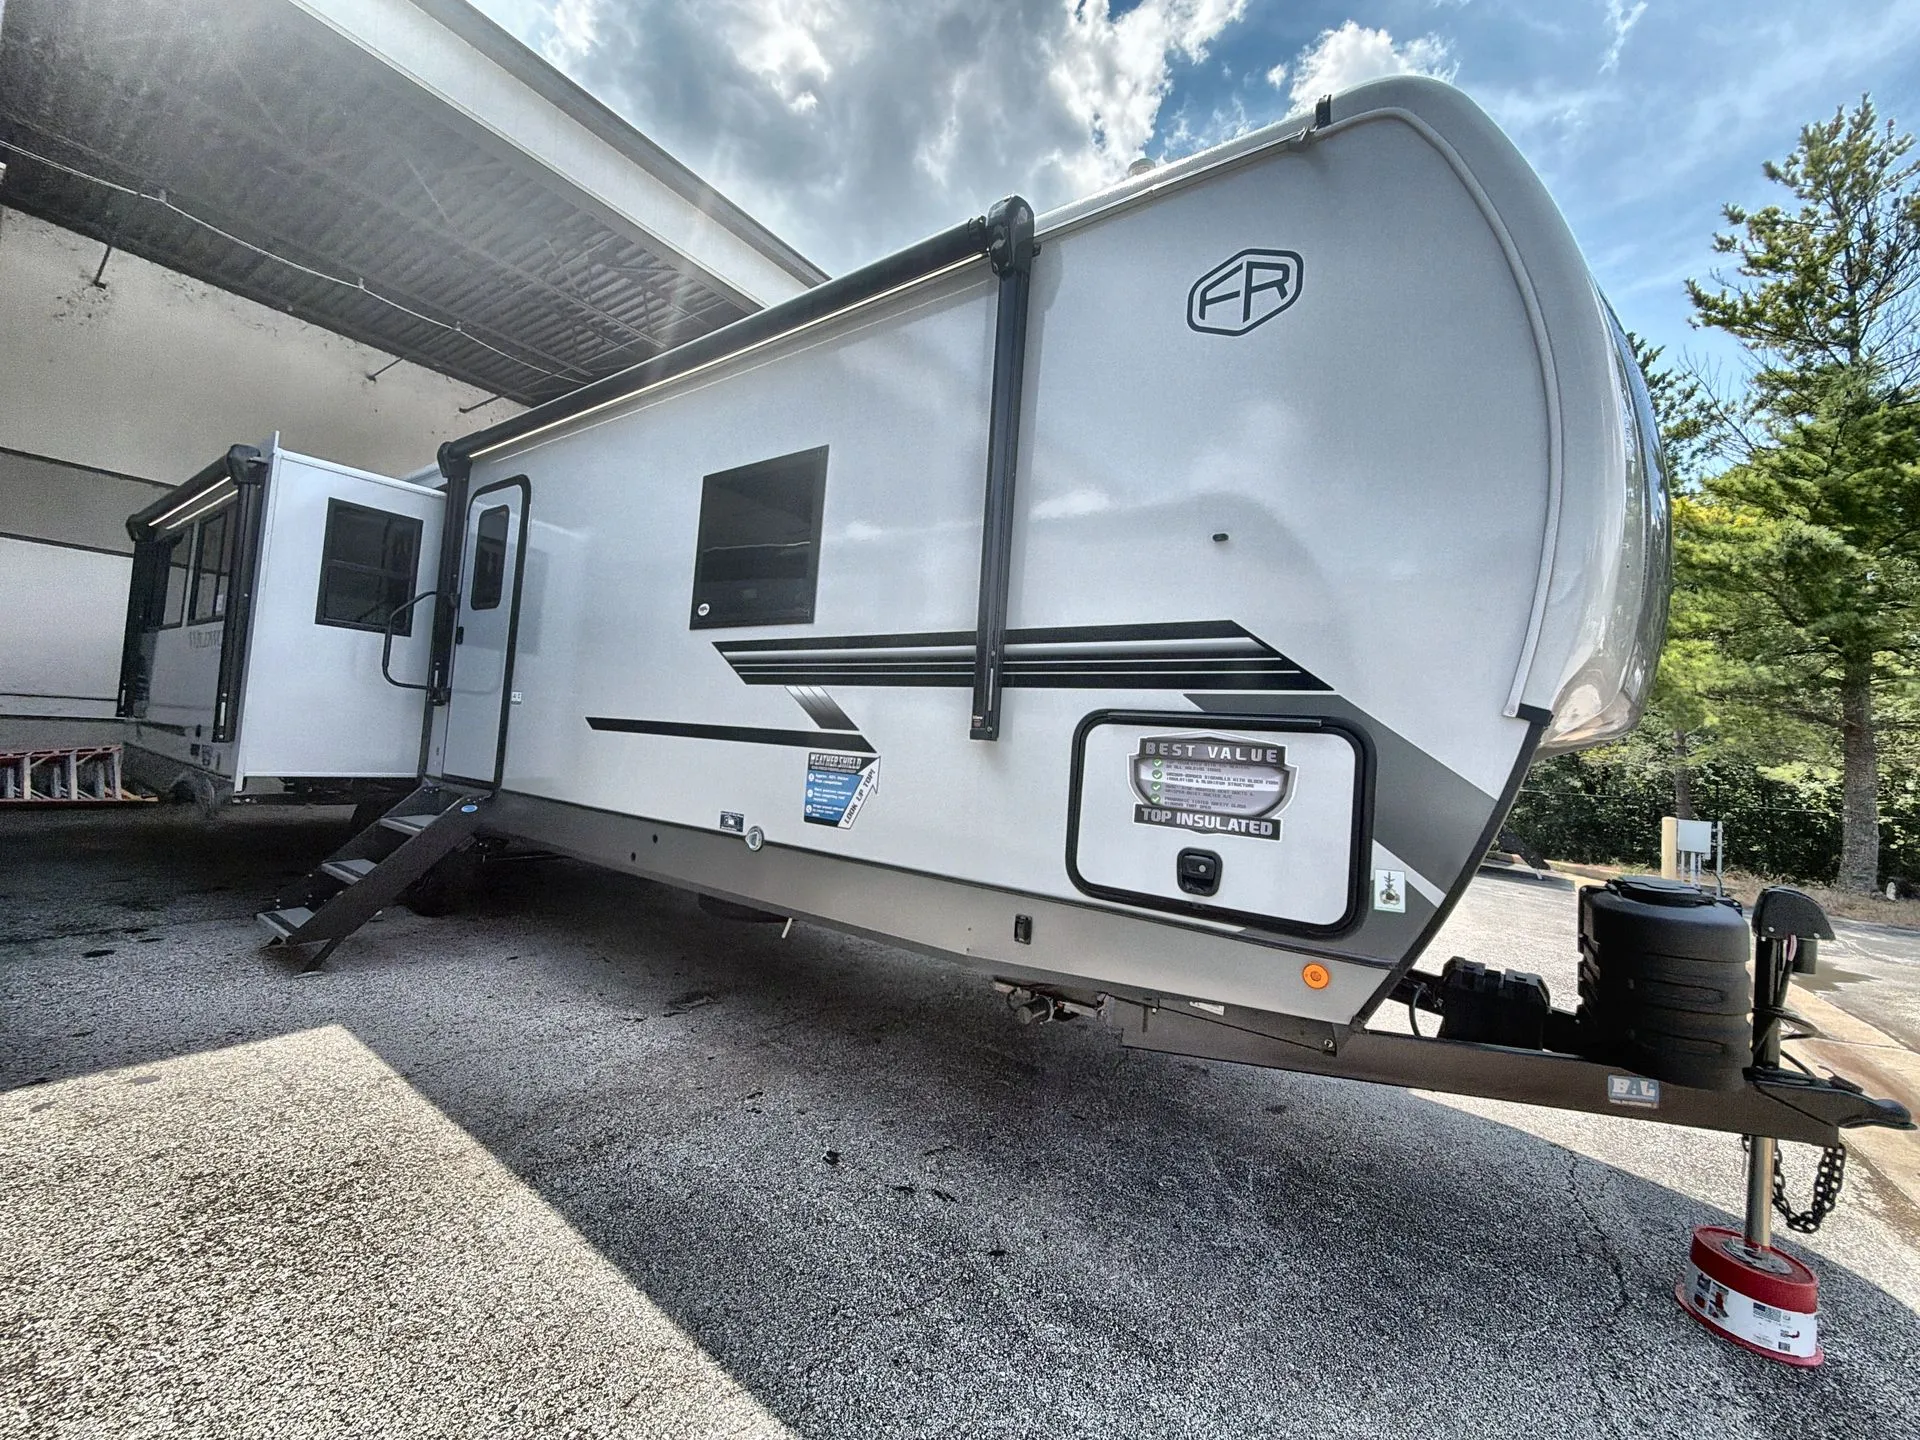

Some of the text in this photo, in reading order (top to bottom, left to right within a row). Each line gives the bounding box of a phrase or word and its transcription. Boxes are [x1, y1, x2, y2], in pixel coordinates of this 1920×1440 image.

[1145, 741, 1278, 763] BEST VALUE
[844, 804, 858, 825] LOOK
[855, 789, 864, 802] UP
[1141, 807, 1273, 836] TOP INSULATED
